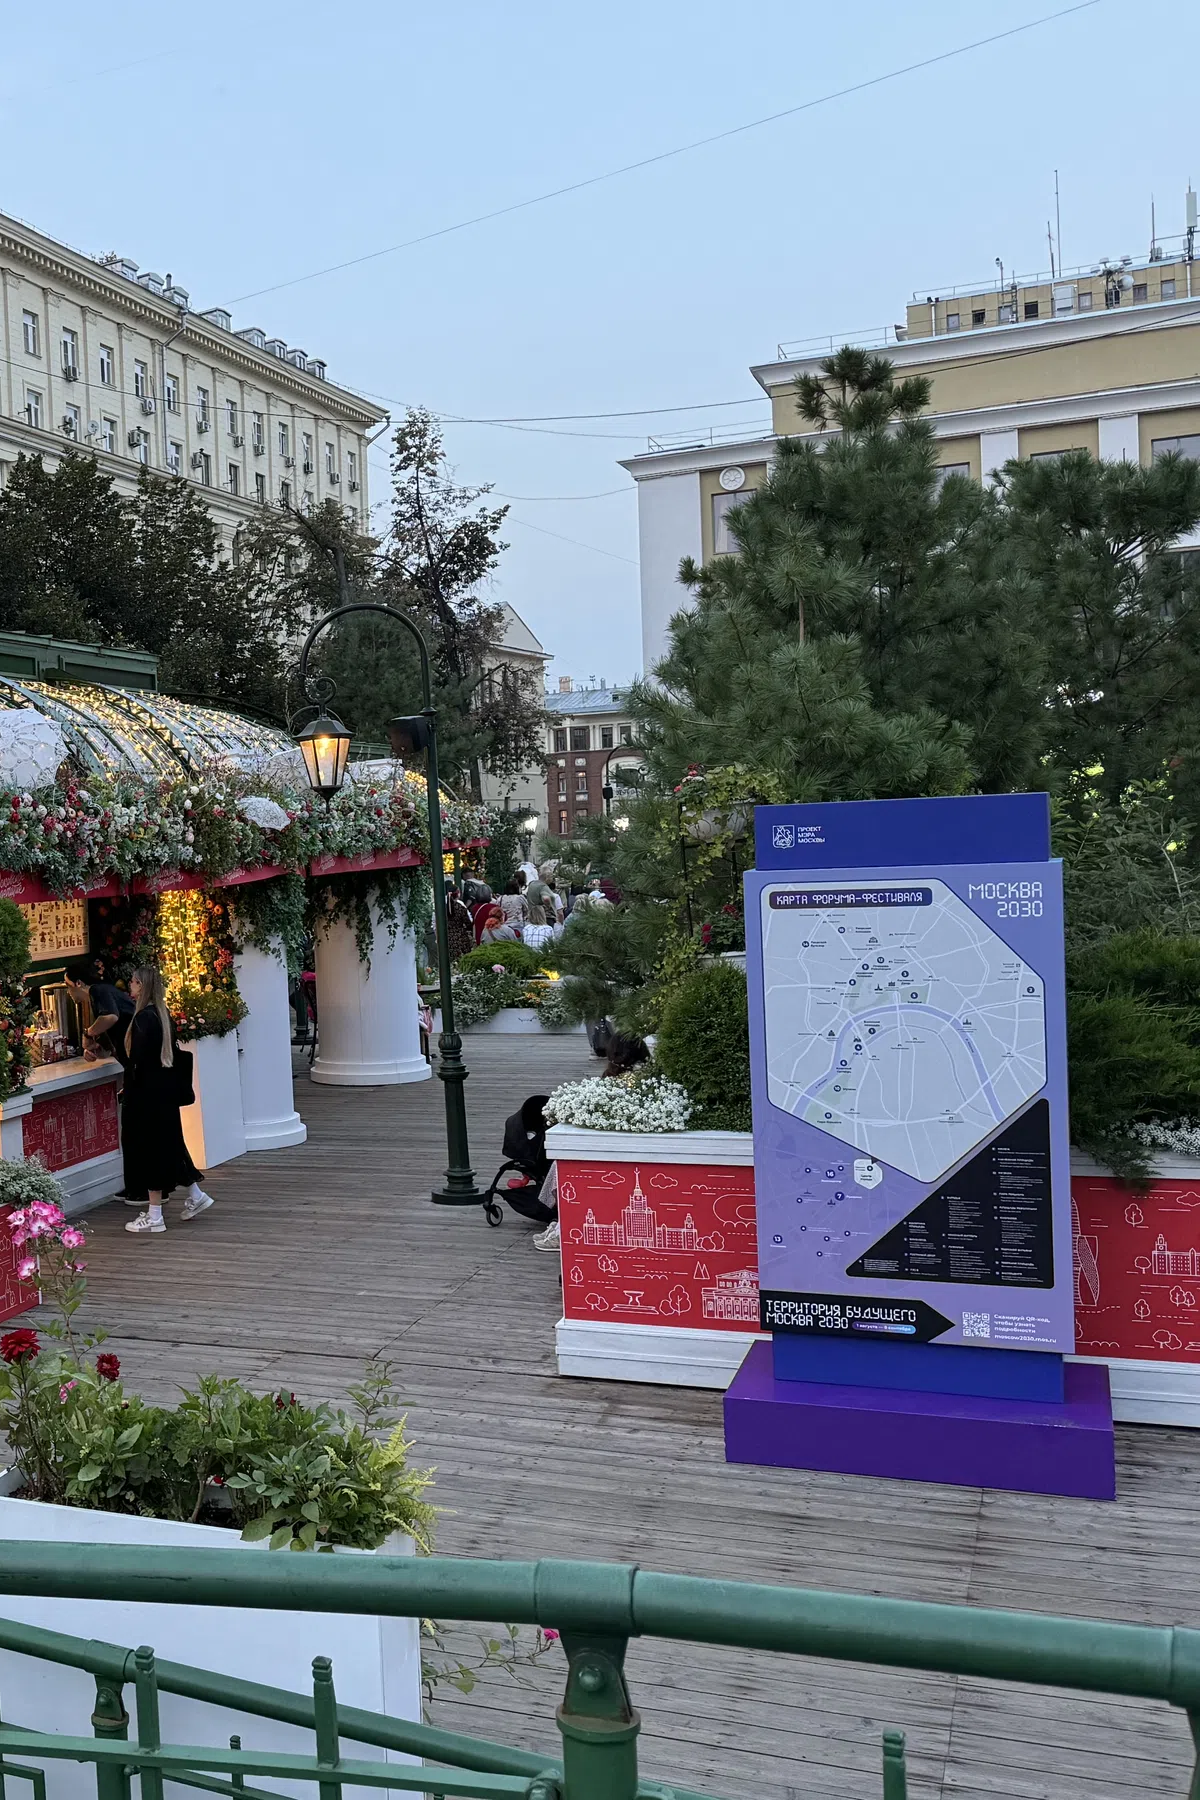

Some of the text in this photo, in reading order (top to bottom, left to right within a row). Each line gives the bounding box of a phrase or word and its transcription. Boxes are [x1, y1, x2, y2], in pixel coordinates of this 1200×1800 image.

[776, 892, 923, 905] КАРТА ФОРУМА-ФЕСТИВАЛЯ
[968, 881, 1043, 900] МОСКВА
[997, 900, 1043, 918] 2030
[766, 1300, 917, 1323] ТЕРРИТОРИЯ БУДУЩЕГО
[766, 1312, 849, 1330] МОСКВА 2030
[994, 1334, 1057, 1343] moscow2030.mos.ru
